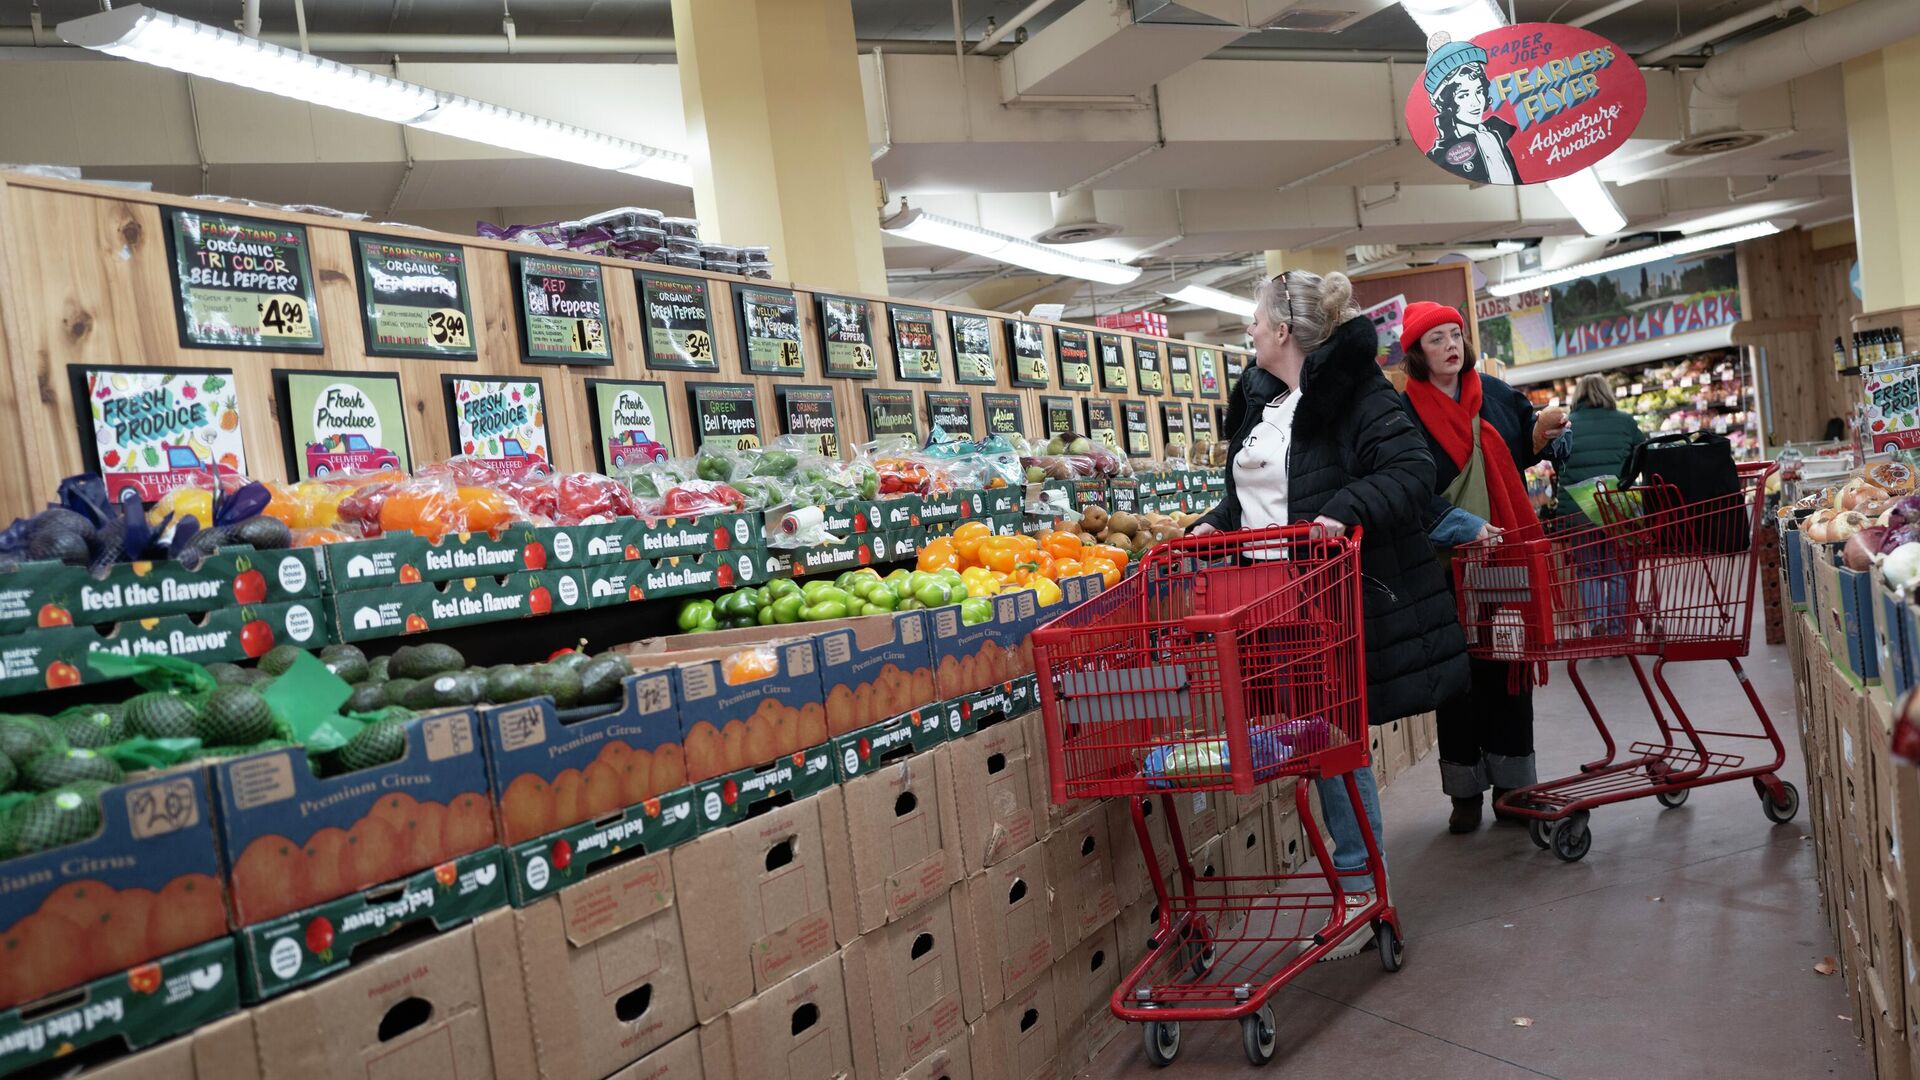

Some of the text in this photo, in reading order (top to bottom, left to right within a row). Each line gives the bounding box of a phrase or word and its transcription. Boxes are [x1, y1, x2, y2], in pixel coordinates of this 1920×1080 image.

[1487, 32, 1543, 58] RADER
[1511, 42, 1553, 65] JOE'S
[1491, 45, 1616, 105] FEARLESS
[1519, 73, 1602, 125] FLYER
[1529, 103, 1620, 155] Adventure
[1546, 120, 1614, 165] Awaits!
[202, 222, 277, 243] FARMSTAND
[207, 239, 274, 258] ORGANIC
[382, 245, 442, 263] FARMSTAND
[197, 251, 290, 273] TRI COLOR
[386, 260, 441, 276] ORGANIC
[536, 262, 583, 277] FARMSTAND
[190, 267, 298, 292] BELL PEPPERS
[542, 277, 566, 293] RED
[528, 291, 600, 318] Bell Peppers
[659, 292, 693, 304] ORGANIC
[257, 299, 303, 334] $4.99
[650, 302, 706, 320] GREEN PEPPERS
[756, 305, 780, 318] YELLOW
[427, 311, 464, 344] $3.99
[841, 323, 860, 334] SWEET
[1563, 291, 1739, 355] LINCOLN PARK
[684, 333, 710, 358] $3.49
[839, 331, 865, 343] PEPPERS
[103, 387, 172, 426] FRESH
[326, 388, 365, 410] Fresh
[463, 391, 504, 420] FRESH
[619, 394, 643, 410] Fresh
[709, 400, 736, 414] GREEN
[796, 402, 819, 413] ORANGE
[115, 402, 206, 446] PRODUCE
[317, 408, 376, 429] Produce
[471, 404, 526, 439] PRODUCE
[614, 409, 652, 426] Produce
[704, 413, 756, 434] Bell Peppers
[790, 413, 835, 433] Bell Peppers
[951, 414, 968, 426] PEARS
[992, 408, 1015, 426] Asian
[997, 422, 1015, 432] PEARS
[330, 454, 369, 464] DELIVERED
[1076, 490, 1104, 503] RAINBOW
[829, 515, 851, 530] flavor
[643, 529, 708, 549] feel the flavor
[282, 562, 301, 571] green
[426, 545, 515, 571] feel the flavor
[806, 551, 821, 566] feel
[820, 550, 833, 564] the
[833, 548, 855, 562] flavor
[282, 570, 302, 578] house
[647, 568, 712, 590] feel the flavor
[80, 577, 221, 611] feel the flavor
[289, 611, 308, 619] green
[432, 592, 521, 619] feel the flavor
[290, 618, 309, 626] house
[169, 630, 228, 655] flavor
[957, 627, 1002, 646] Premium Citrus
[851, 651, 905, 673] Premium Citrus
[718, 684, 791, 710] Premium Citrus
[547, 724, 643, 759] Premium Citrus
[872, 726, 912, 749] flavor the feel
[741, 766, 792, 793] flavor the feel
[300, 770, 432, 818] Premium Citrus
[576, 818, 644, 853] flavor the feel
[60, 854, 137, 877] Citrus
